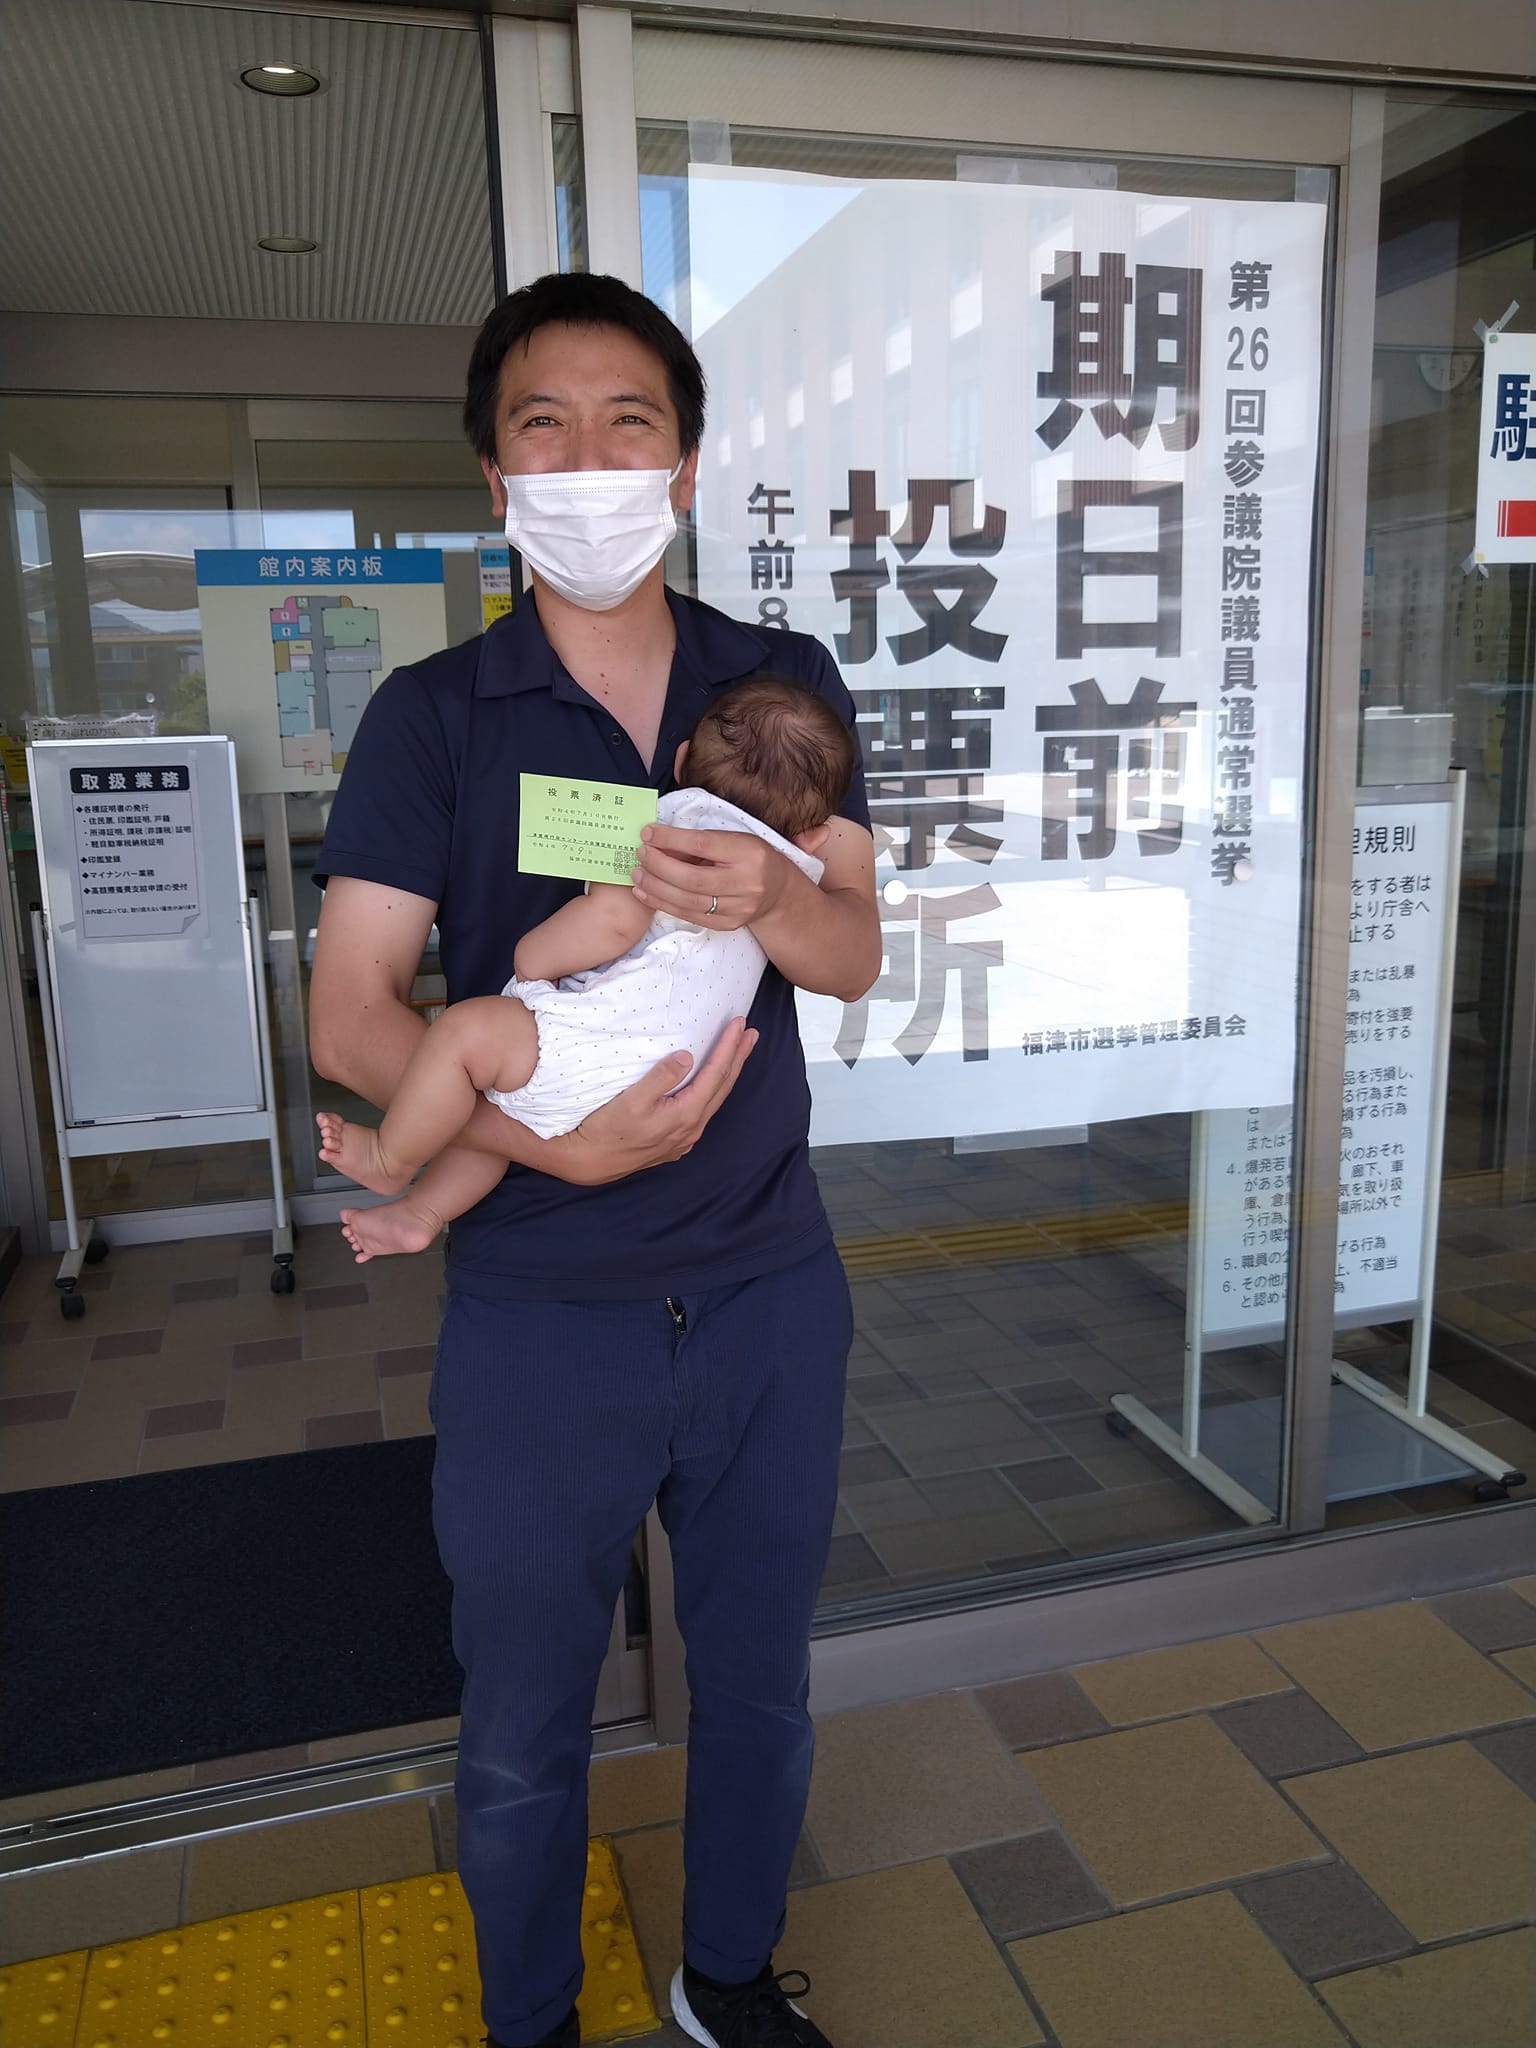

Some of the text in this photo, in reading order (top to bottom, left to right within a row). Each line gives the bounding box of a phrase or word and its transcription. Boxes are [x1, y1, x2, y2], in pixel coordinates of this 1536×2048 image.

[1034, 249, 1204, 862] 期日前
[258, 556, 383, 577] 館内案内板
[1210, 260, 1273, 888] 第26回参議院議員通常選挙
[827, 469, 1010, 1070] 投票所
[80, 771, 180, 790] 取扱業務
[548, 787, 625, 806] 投票済証
[83, 804, 150, 813] 各種証明書の発行
[1351, 874, 1432, 896] をする者は
[1349, 898, 1431, 920] より庁舎へ
[1349, 964, 1416, 983] または乱暴
[1345, 1005, 1413, 1026] 寄付を強要
[1021, 1013, 1248, 1056] 福津市選挙管理委員会
[1344, 1025, 1412, 1045] 売りをする
